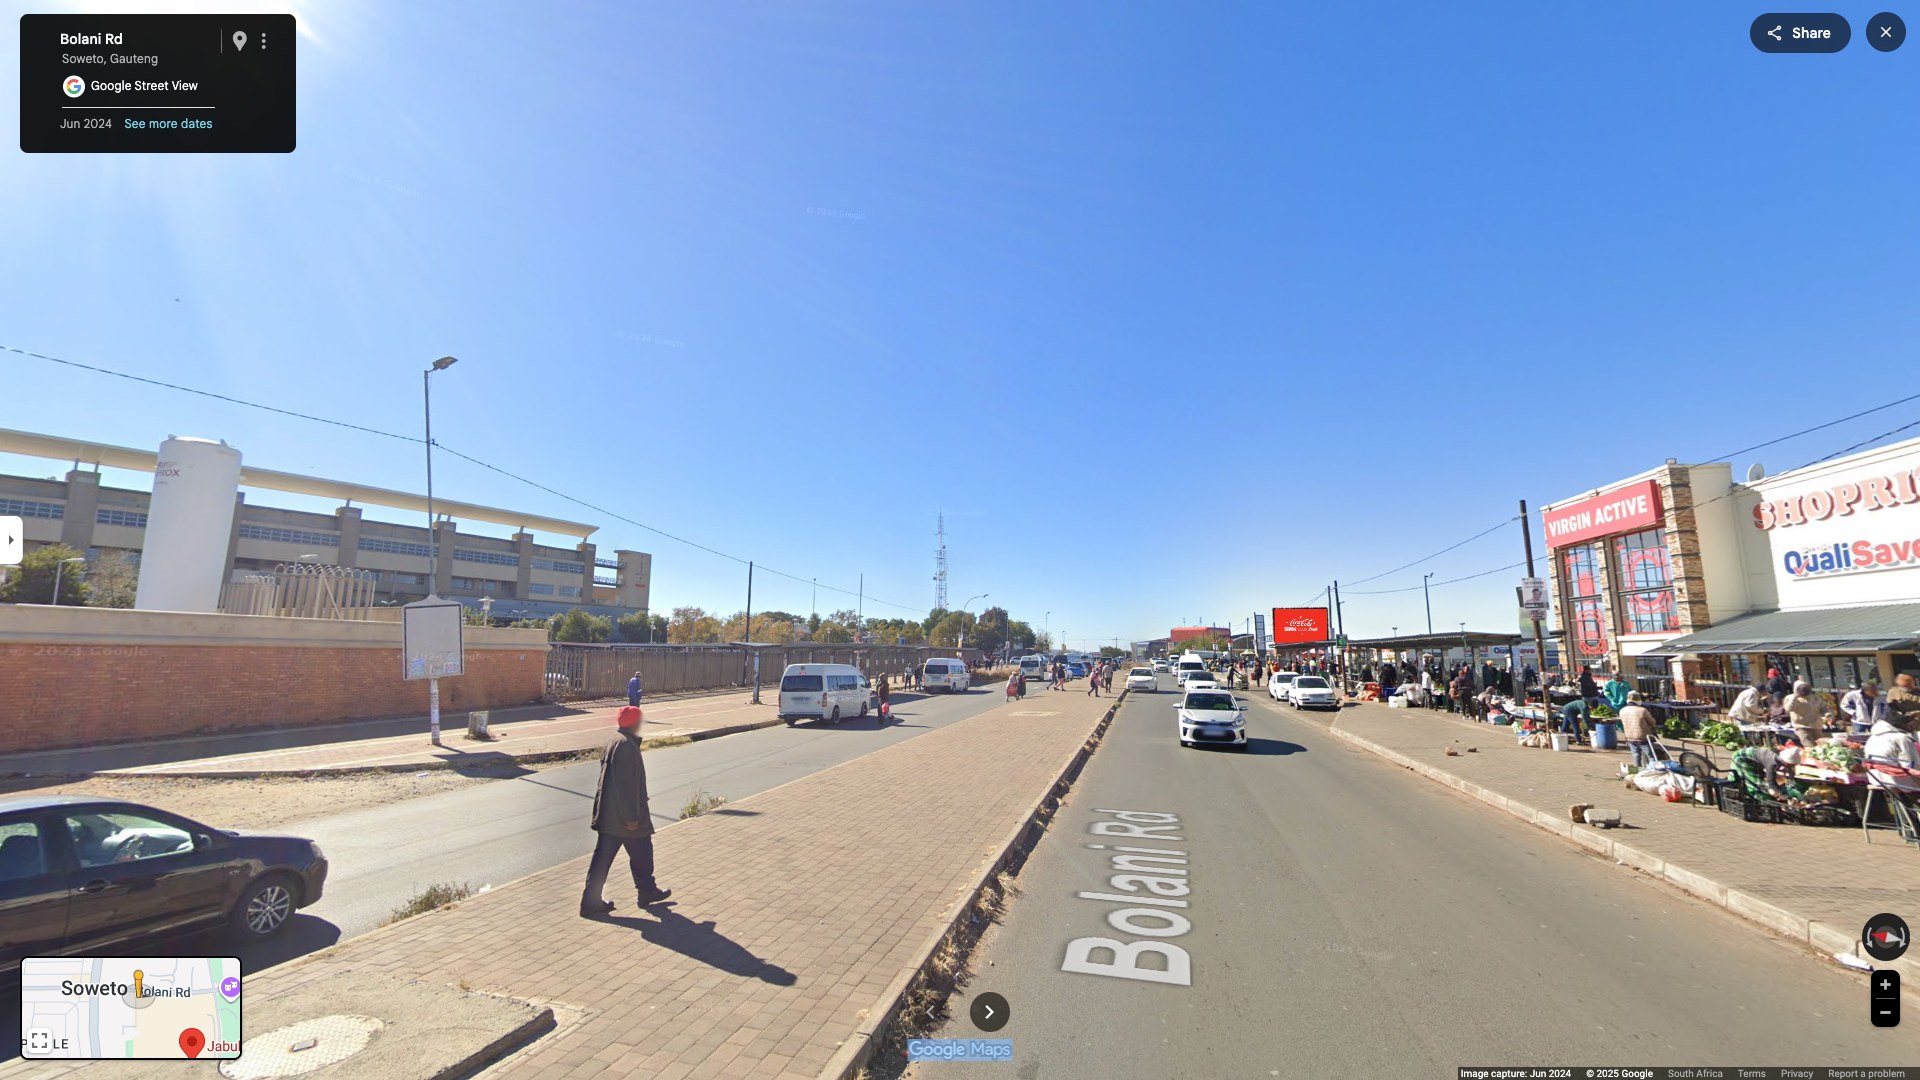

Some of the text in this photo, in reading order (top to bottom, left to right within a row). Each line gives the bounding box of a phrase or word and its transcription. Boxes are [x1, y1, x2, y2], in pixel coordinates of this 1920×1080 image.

[1548, 494, 1648, 537] VIRGIN ACTIVE
[1752, 467, 1920, 531] SHOPRI
